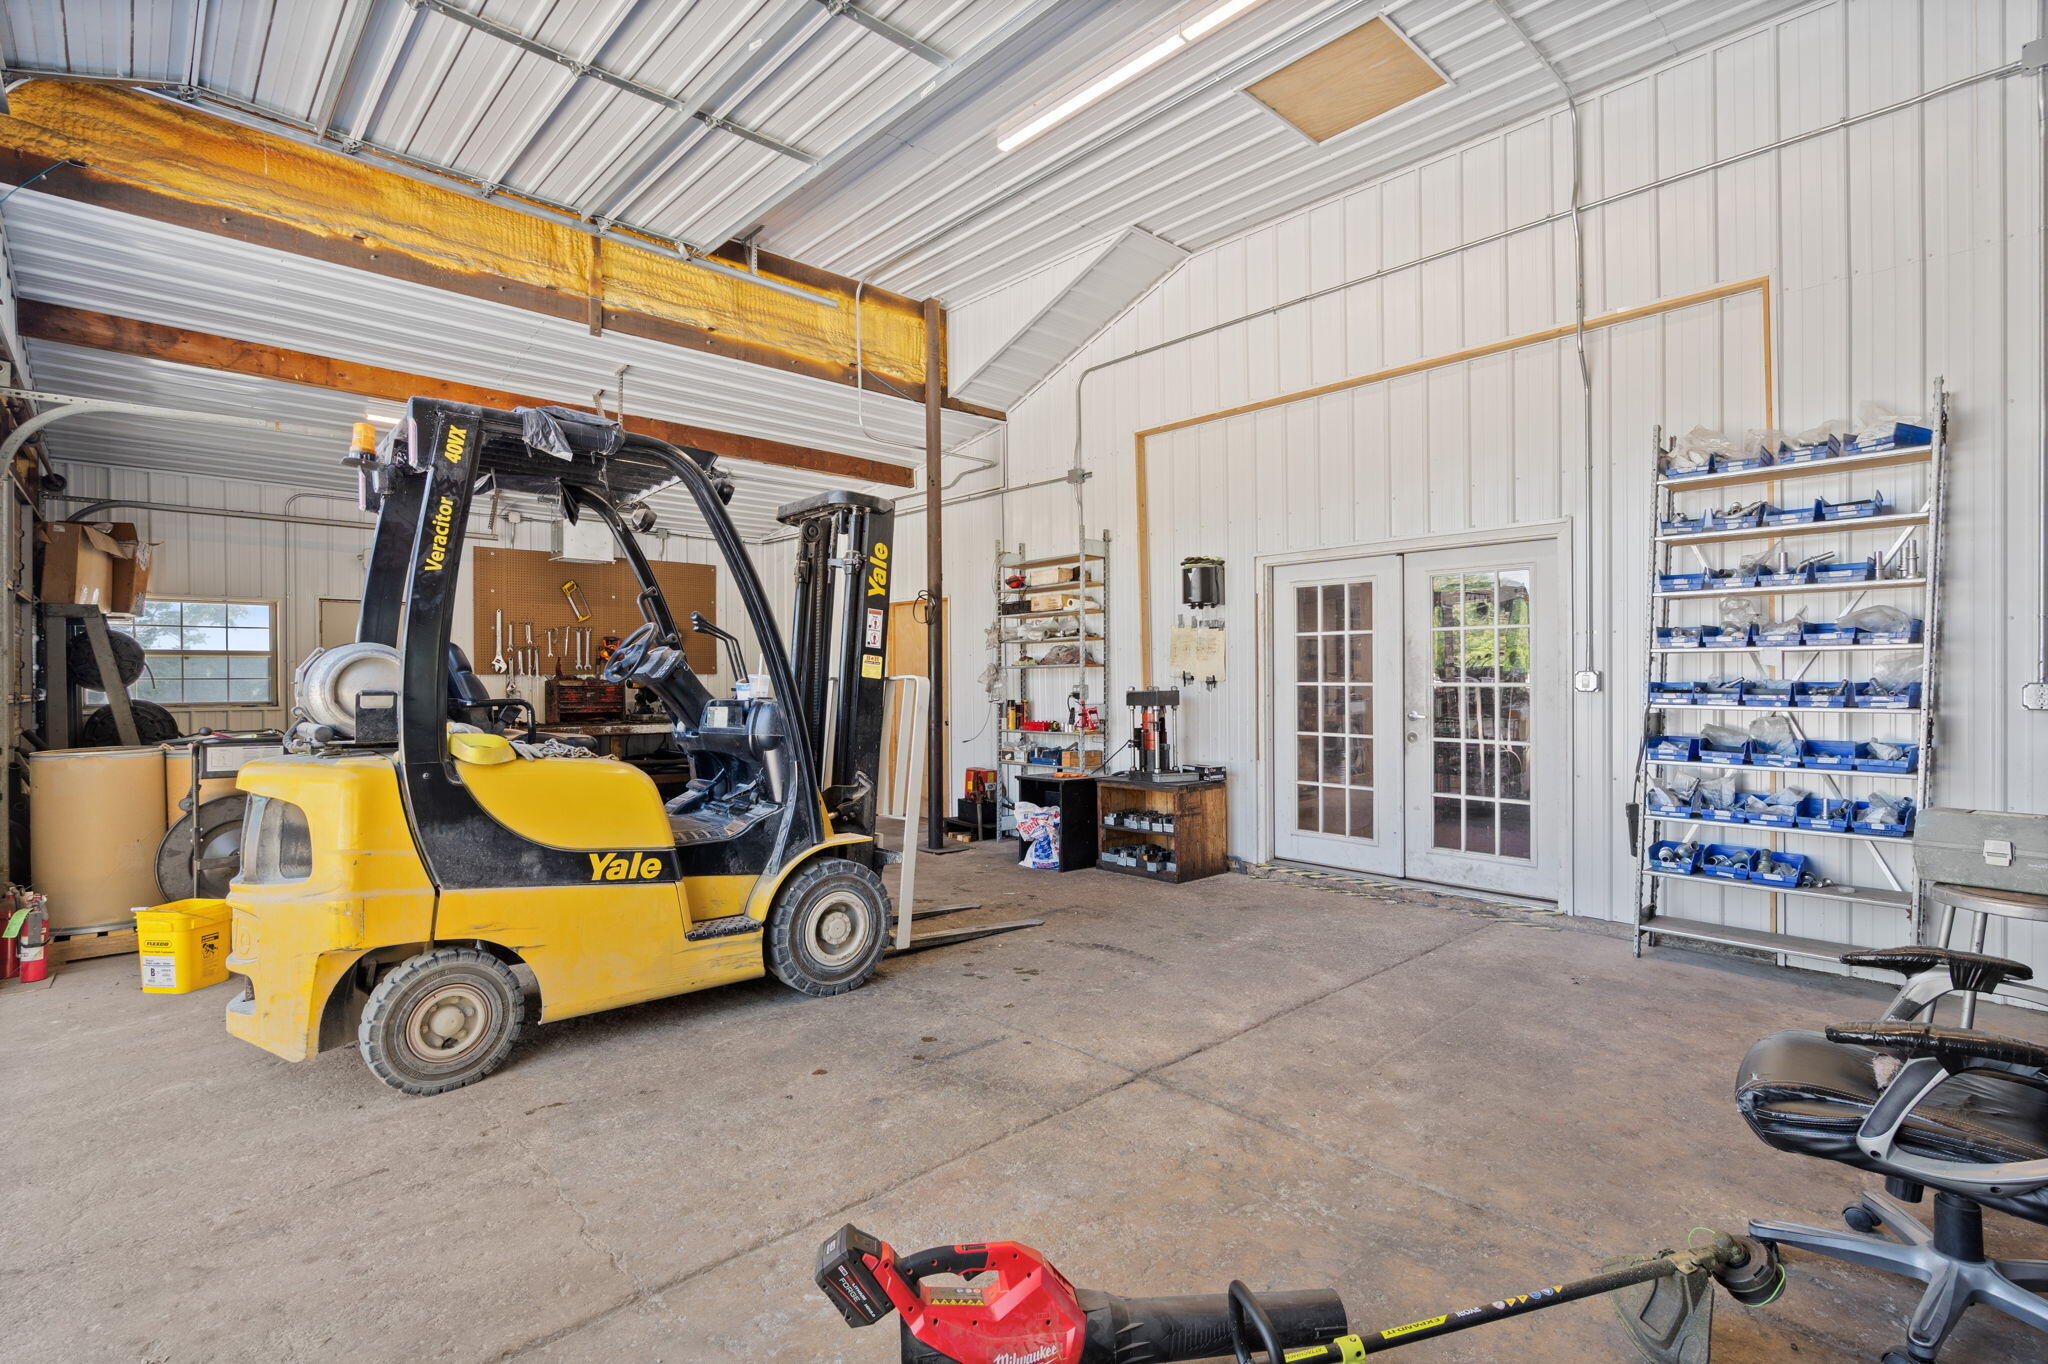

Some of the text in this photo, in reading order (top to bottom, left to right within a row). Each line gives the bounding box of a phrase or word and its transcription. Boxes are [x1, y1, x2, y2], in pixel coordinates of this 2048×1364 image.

[444, 424, 467, 465] 40VX
[424, 496, 454, 571] Veracitor
[868, 542, 889, 597] Yale
[588, 852, 663, 881] Yale
[839, 1277, 861, 1303] FORGE
[993, 1344, 1057, 1364] Milwaukee
